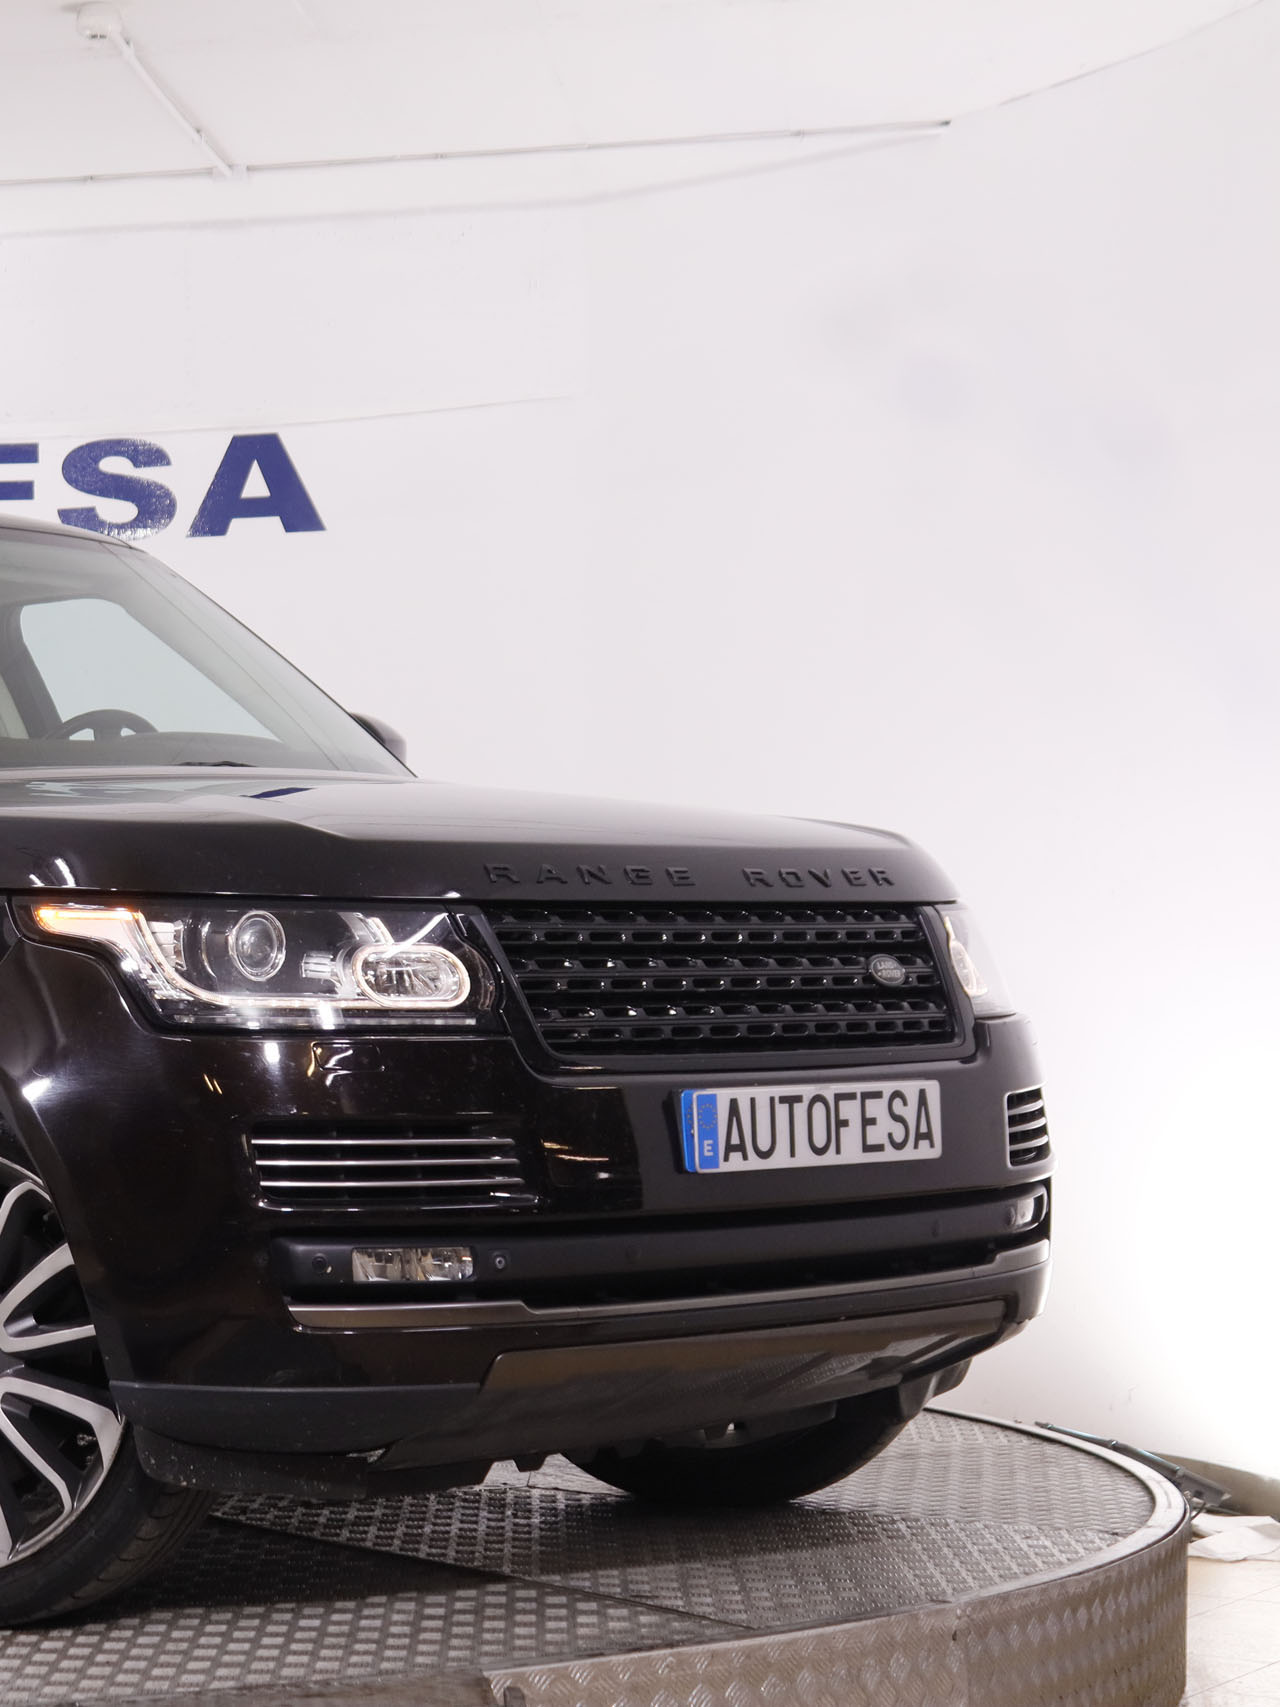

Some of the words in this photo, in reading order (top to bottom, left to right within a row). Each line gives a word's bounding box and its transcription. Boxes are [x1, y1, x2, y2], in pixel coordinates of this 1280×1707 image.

[483, 863, 696, 887] RANGE
[741, 867, 896, 889] ROVER
[722, 1087, 936, 1164] AUTOFESA
[703, 1139, 714, 1157] E
